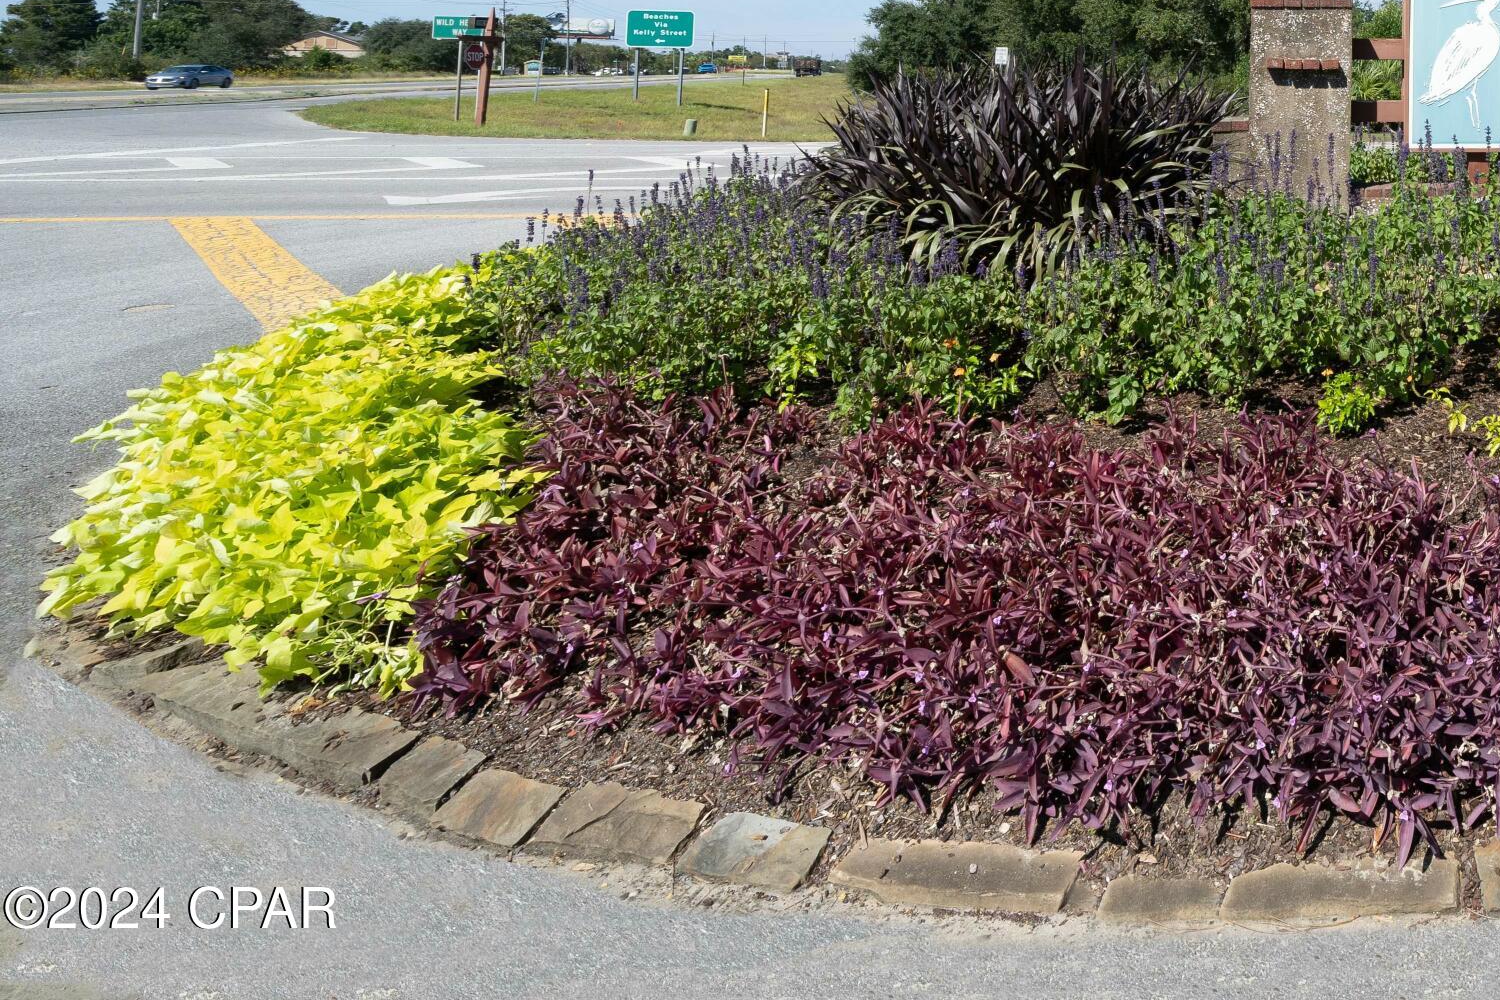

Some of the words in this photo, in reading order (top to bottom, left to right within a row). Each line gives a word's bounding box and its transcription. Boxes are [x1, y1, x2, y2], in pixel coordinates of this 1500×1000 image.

[436, 18, 454, 26] WILD
[452, 28, 467, 36] WAY
[633, 29, 656, 37] Kelly
[467, 51, 484, 62] STOP
